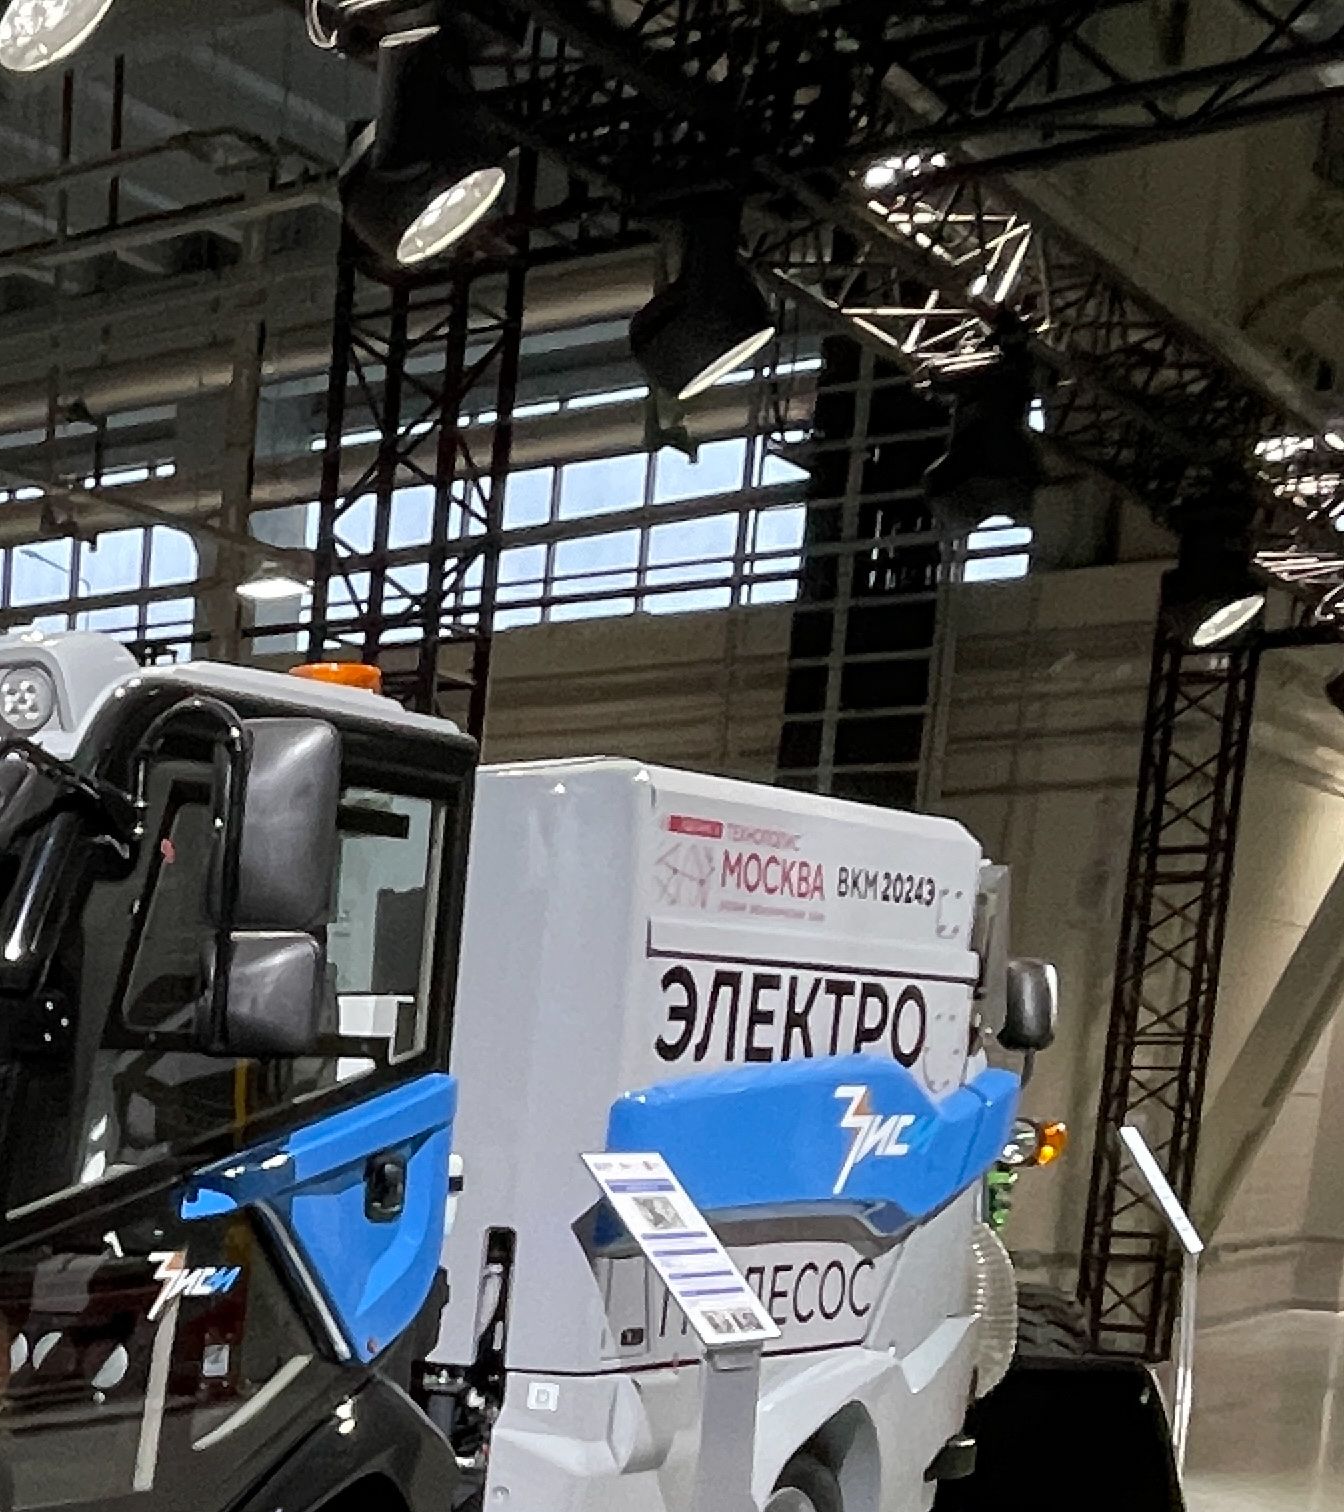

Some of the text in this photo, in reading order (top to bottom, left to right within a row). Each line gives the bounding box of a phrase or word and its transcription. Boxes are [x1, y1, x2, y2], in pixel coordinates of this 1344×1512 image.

[721, 848, 825, 901] МОСКВА
[837, 866, 879, 900] ВКМ
[654, 964, 928, 1068] ЭЛЕКТРО
